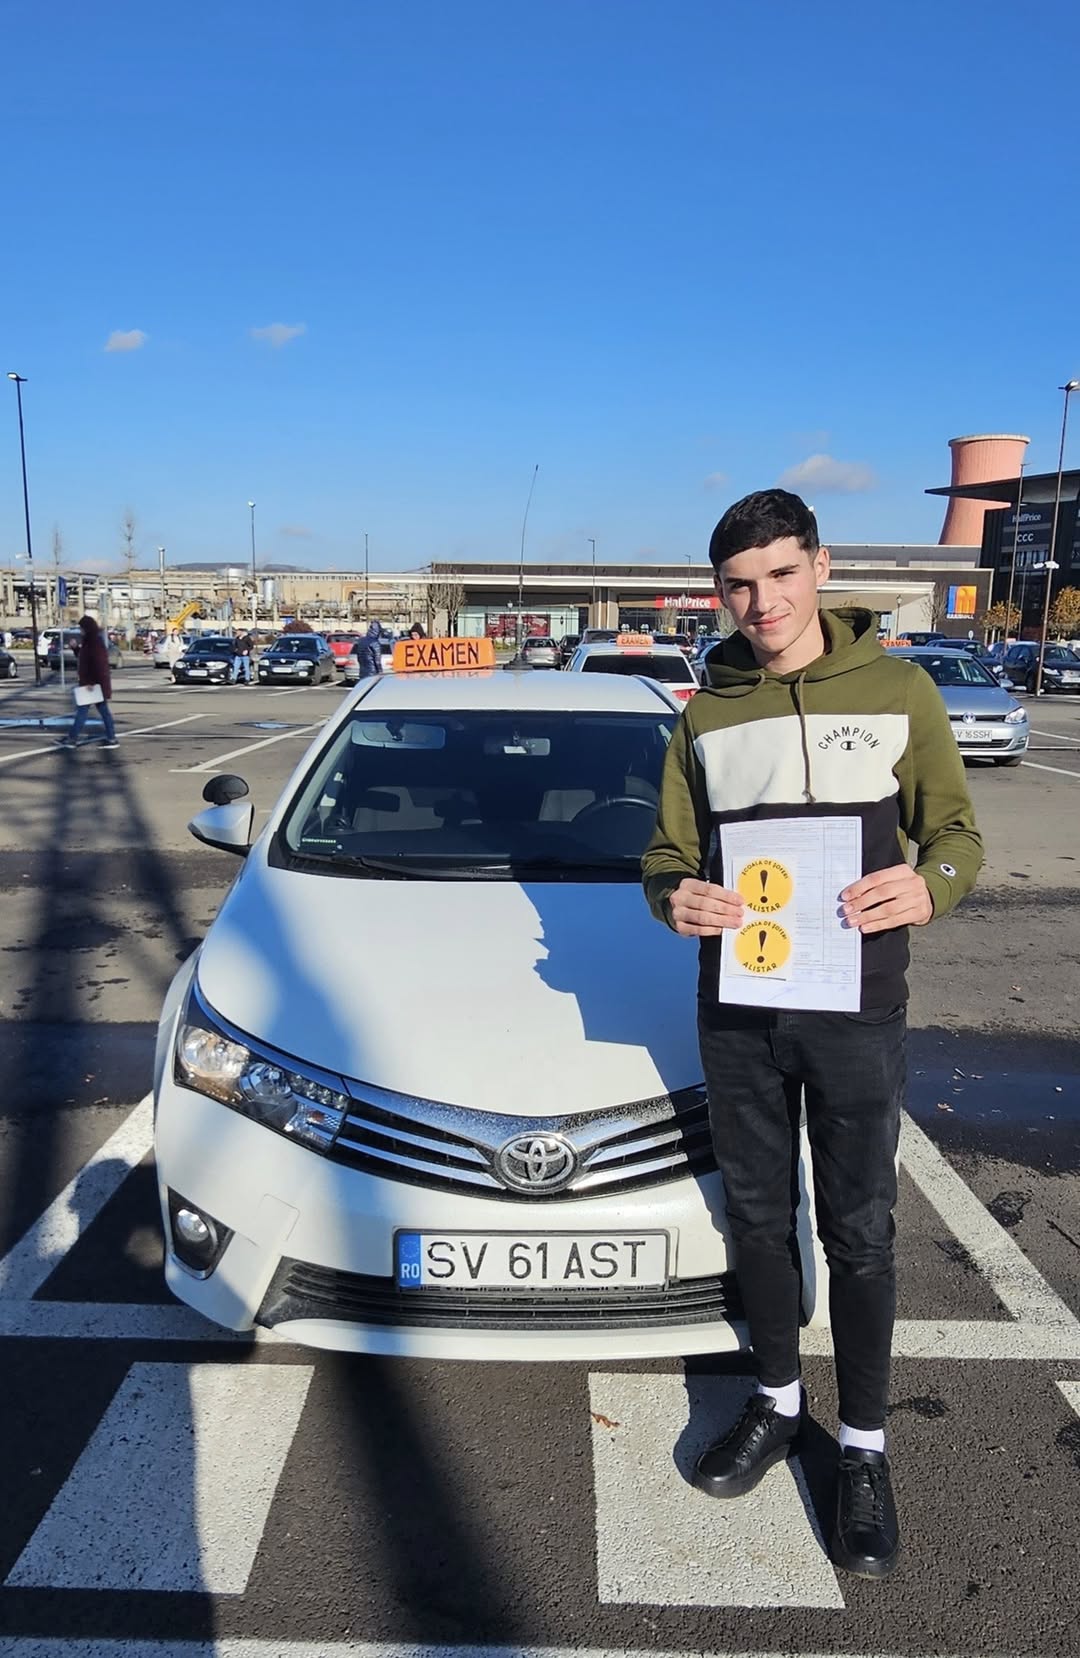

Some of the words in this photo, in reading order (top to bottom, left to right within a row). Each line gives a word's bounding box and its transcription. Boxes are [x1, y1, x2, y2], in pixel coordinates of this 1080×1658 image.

[1017, 533, 1034, 543] CCC
[664, 596, 711, 608] HalPrice
[405, 642, 479, 667] EXAMEN
[818, 726, 881, 750] CHAMPION
[746, 902, 781, 913] ALISTAR
[742, 961, 777, 973] ALISTAR
[427, 1241, 488, 1280] SV
[508, 1242, 549, 1280] 61
[563, 1241, 647, 1279] AST
[401, 1263, 420, 1279] RO
